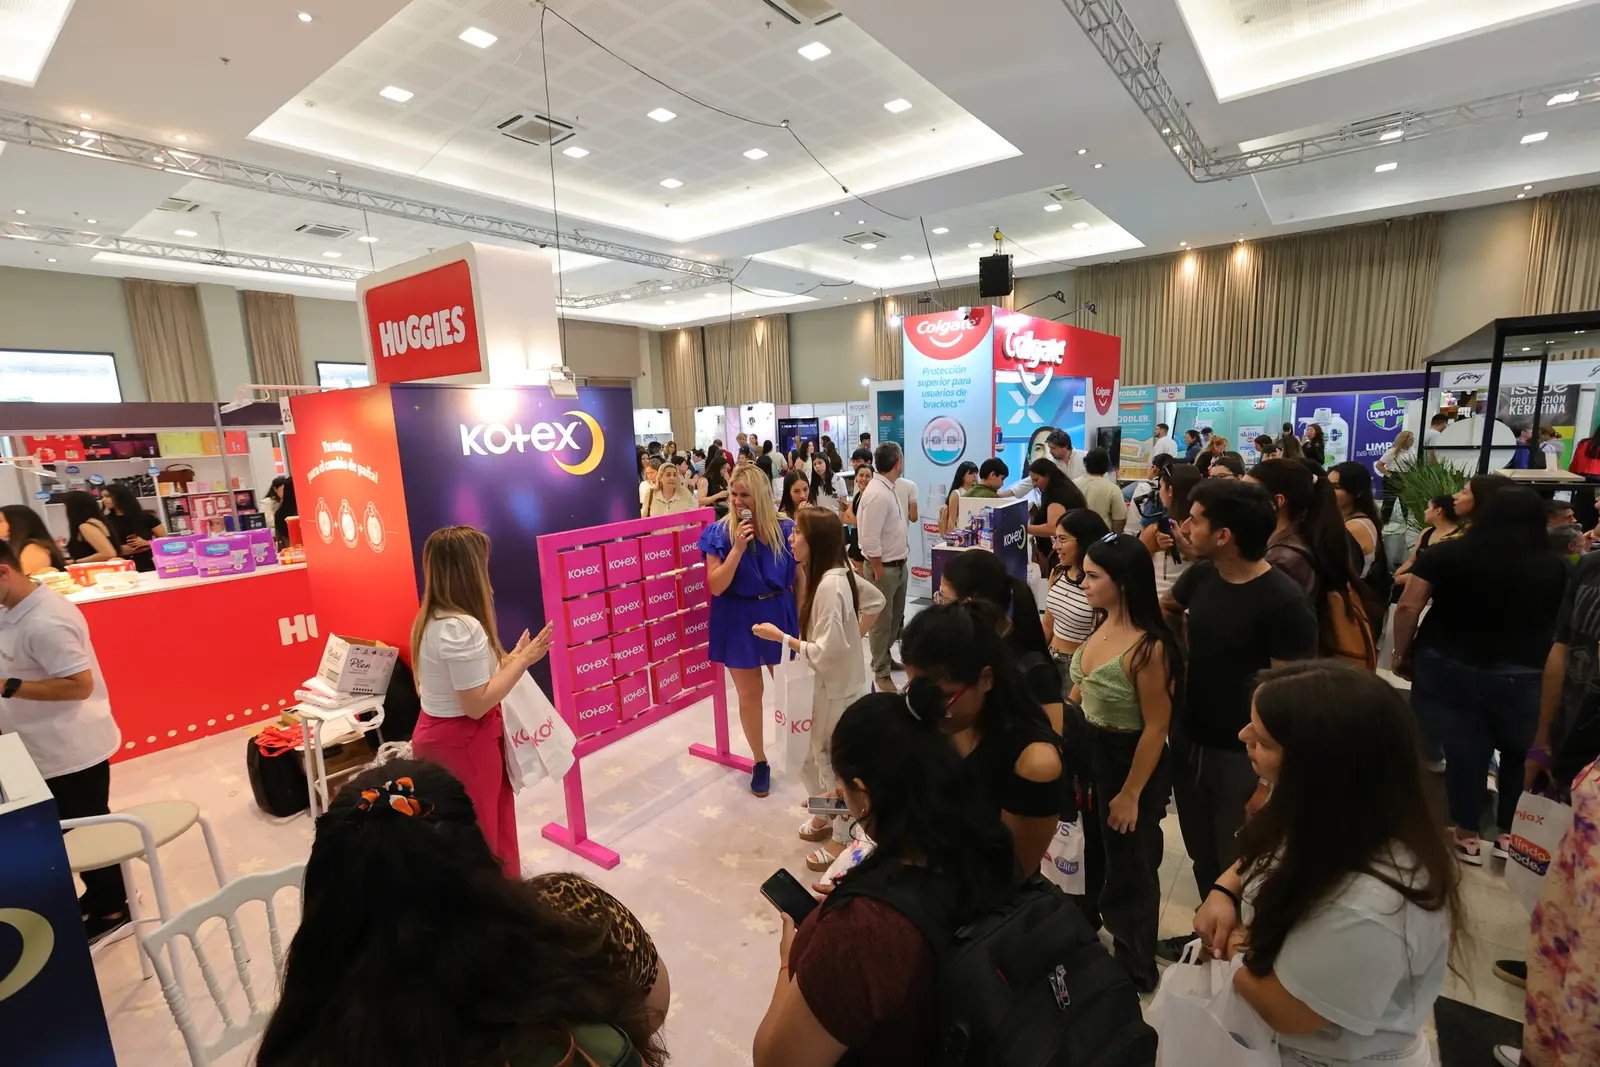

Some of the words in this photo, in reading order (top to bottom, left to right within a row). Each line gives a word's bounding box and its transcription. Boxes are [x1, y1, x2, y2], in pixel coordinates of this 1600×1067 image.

[378, 306, 467, 357] HUGGIES
[916, 319, 976, 336] Colgate
[1003, 327, 1066, 368] Colgate
[922, 364, 967, 375] Protección
[917, 377, 950, 388] superior
[952, 378, 971, 387] para
[921, 388, 955, 397] usuarios
[956, 388, 967, 396] de
[1096, 387, 1111, 397] Colgate
[347, 458, 357, 472] de
[357, 463, 379, 484] pañal
